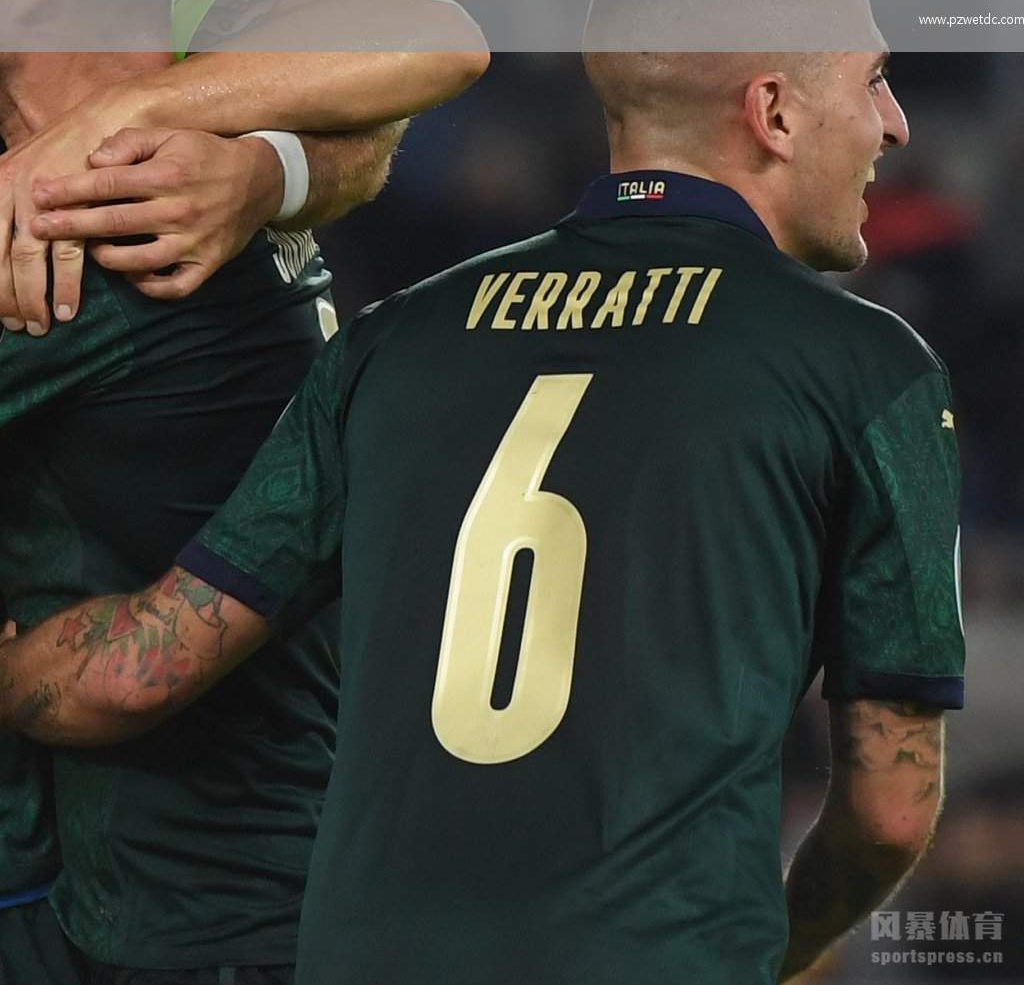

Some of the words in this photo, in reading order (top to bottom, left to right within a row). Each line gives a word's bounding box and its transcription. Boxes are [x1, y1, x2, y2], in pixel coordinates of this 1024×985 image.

[617, 181, 666, 196] ITALIA
[465, 267, 723, 331] VERRATTI
[431, 373, 594, 765] 6
